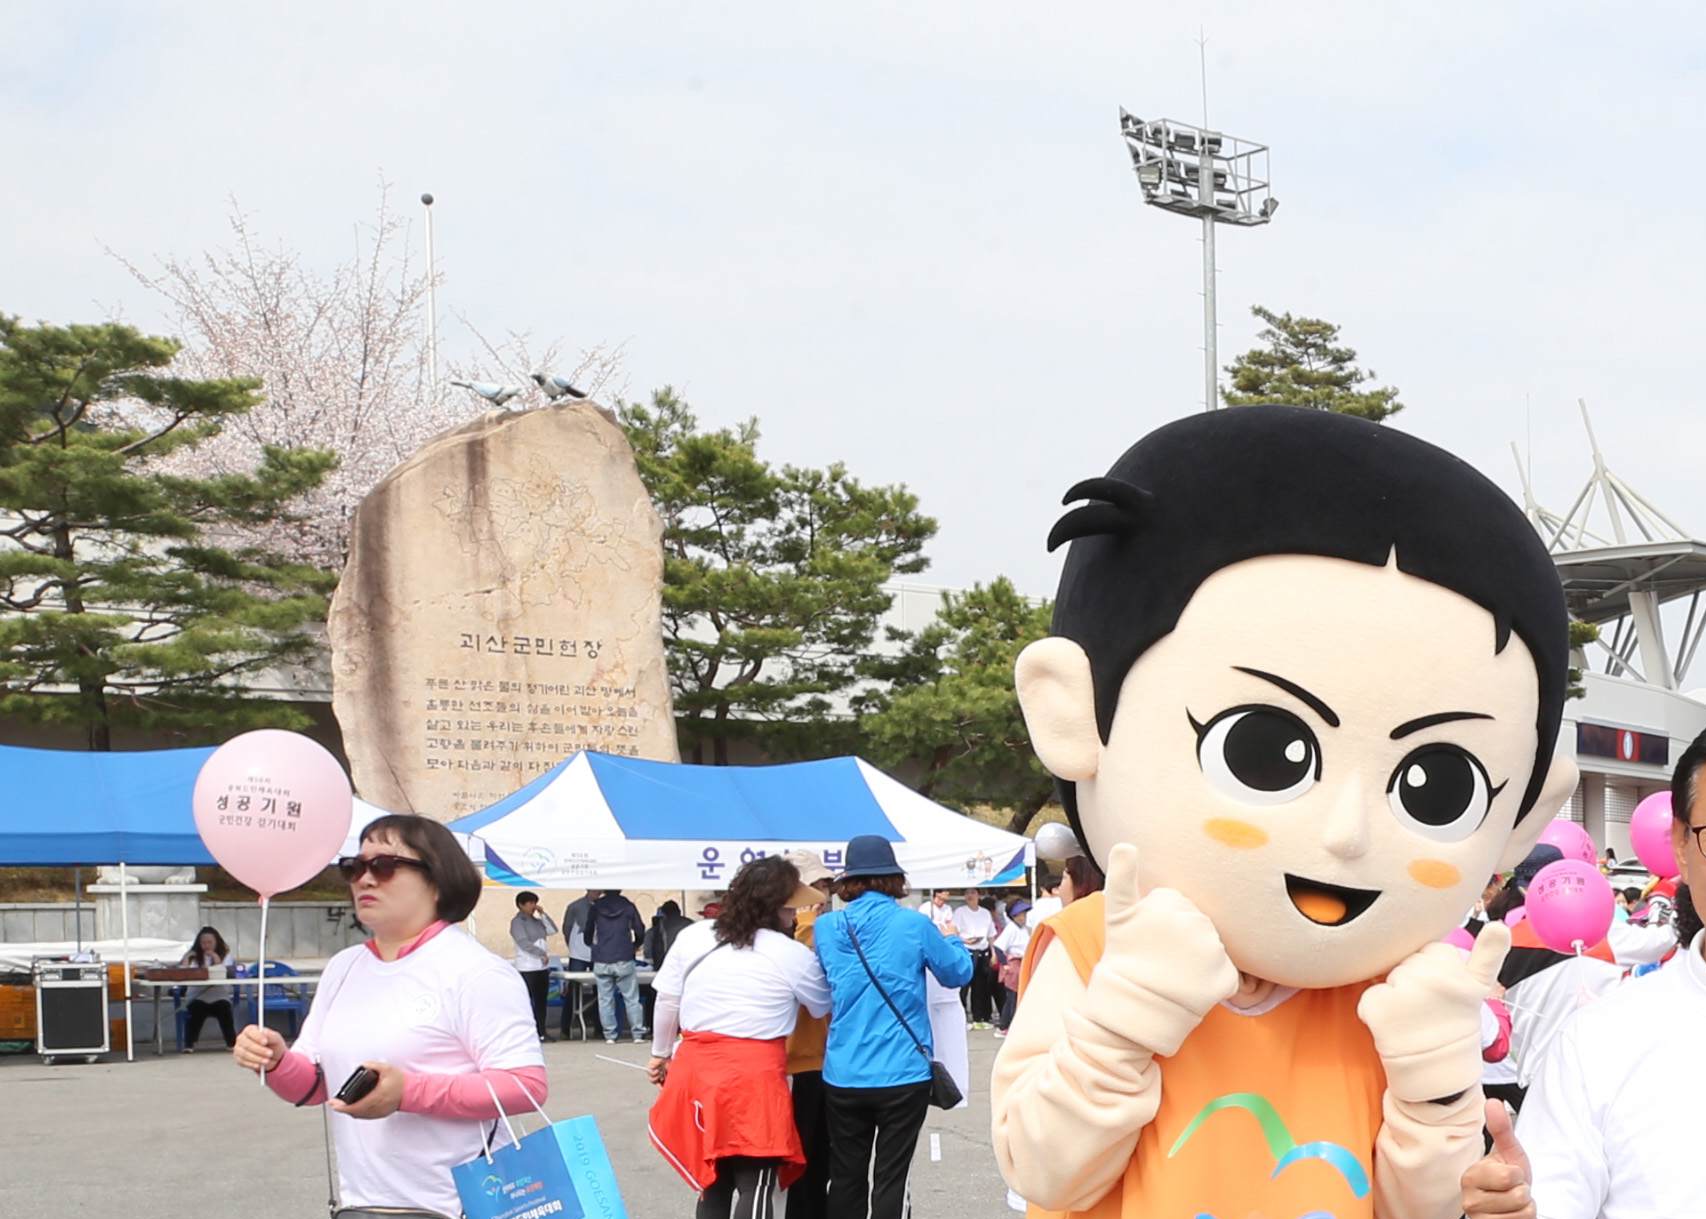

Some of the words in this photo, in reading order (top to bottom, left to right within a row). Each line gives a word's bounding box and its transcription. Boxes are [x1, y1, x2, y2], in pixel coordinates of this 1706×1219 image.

[459, 633, 603, 660] 괴산군민헌장
[425, 677, 449, 690] 푸른
[453, 679, 466, 691] 산
[470, 680, 495, 691] 맑은
[498, 680, 522, 693] 물의
[527, 683, 570, 696] 정기어린
[574, 685, 597, 697] 괴산
[425, 698, 464, 712] 훌륭한
[468, 700, 521, 713] 선조들의
[526, 703, 551, 716] 삶을
[425, 718, 451, 731] 살고
[456, 719, 482, 731] 있는
[486, 719, 524, 732] 우리는
[527, 722, 588, 735] 후손들에게
[425, 737, 465, 750] 고향을
[470, 738, 519, 752] 물려주기
[523, 741, 559, 753] 위하여
[426, 758, 454, 771] 모아
[457, 759, 496, 772] 다음과
[499, 760, 523, 773] 같이
[573, 1135, 591, 1166] 2019
